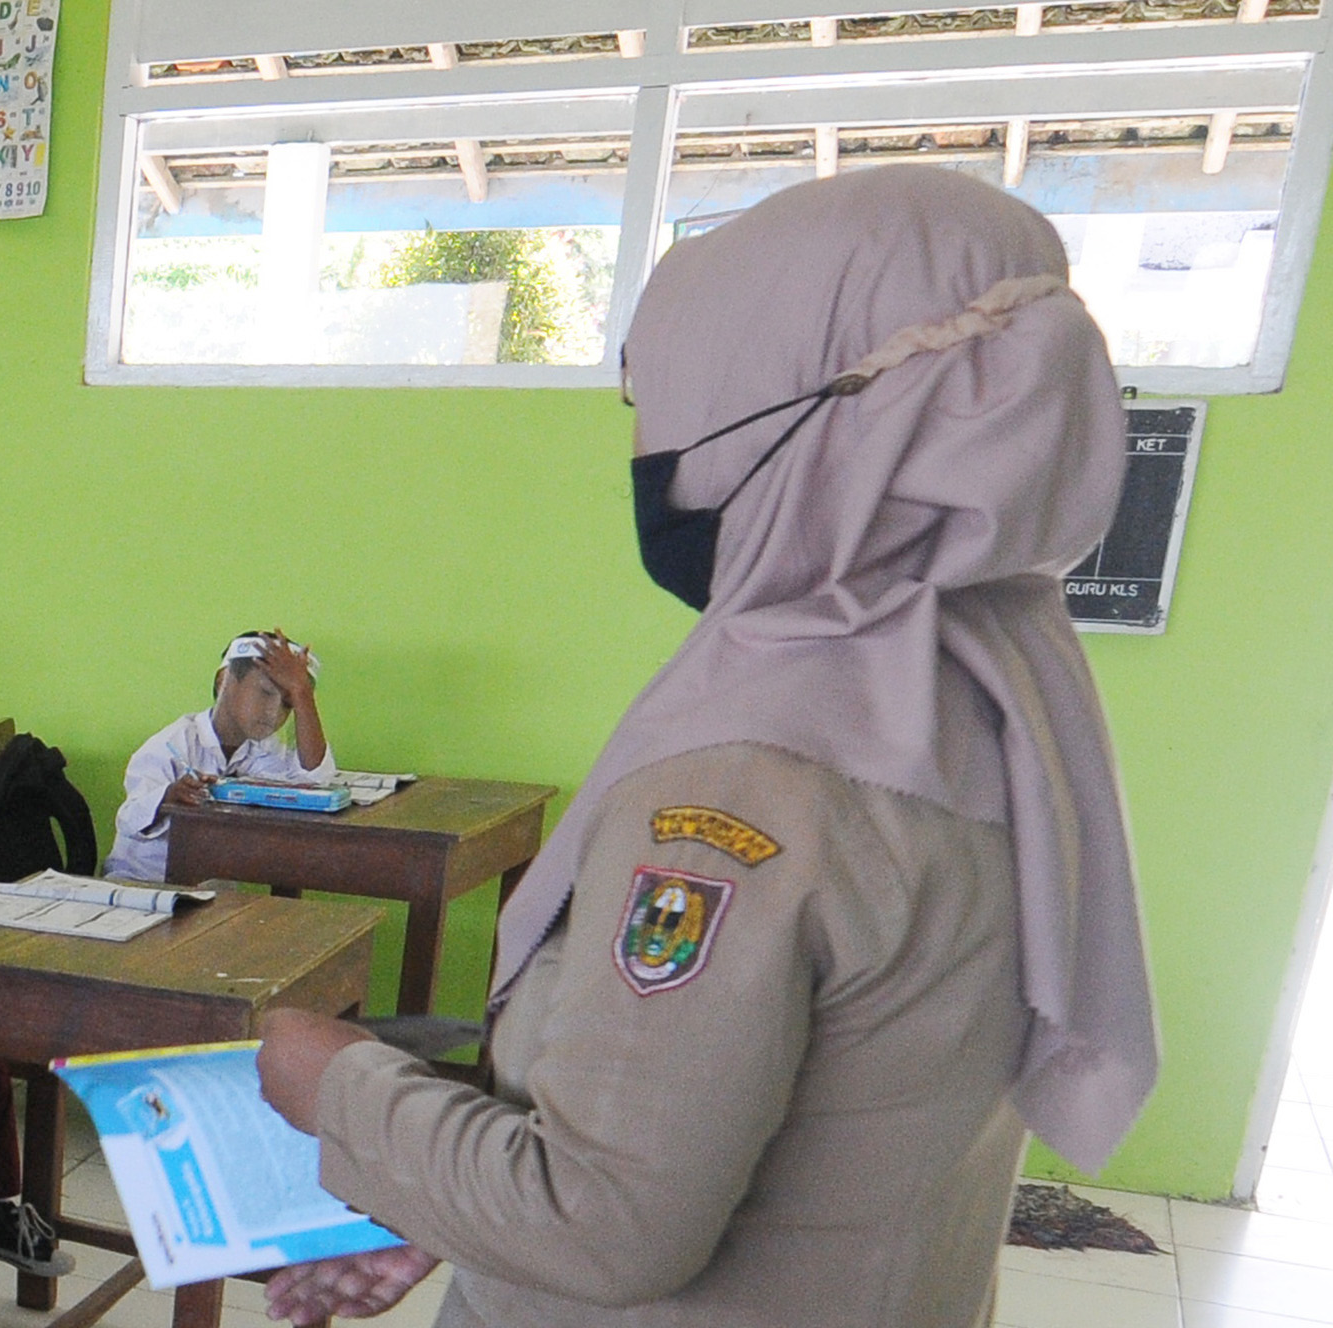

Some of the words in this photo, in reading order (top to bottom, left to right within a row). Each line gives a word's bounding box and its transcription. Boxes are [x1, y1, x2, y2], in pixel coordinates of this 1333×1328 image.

[1136, 438, 1167, 451] KET
[1065, 582, 1106, 596] GURU
[1109, 584, 1138, 596] KLS
